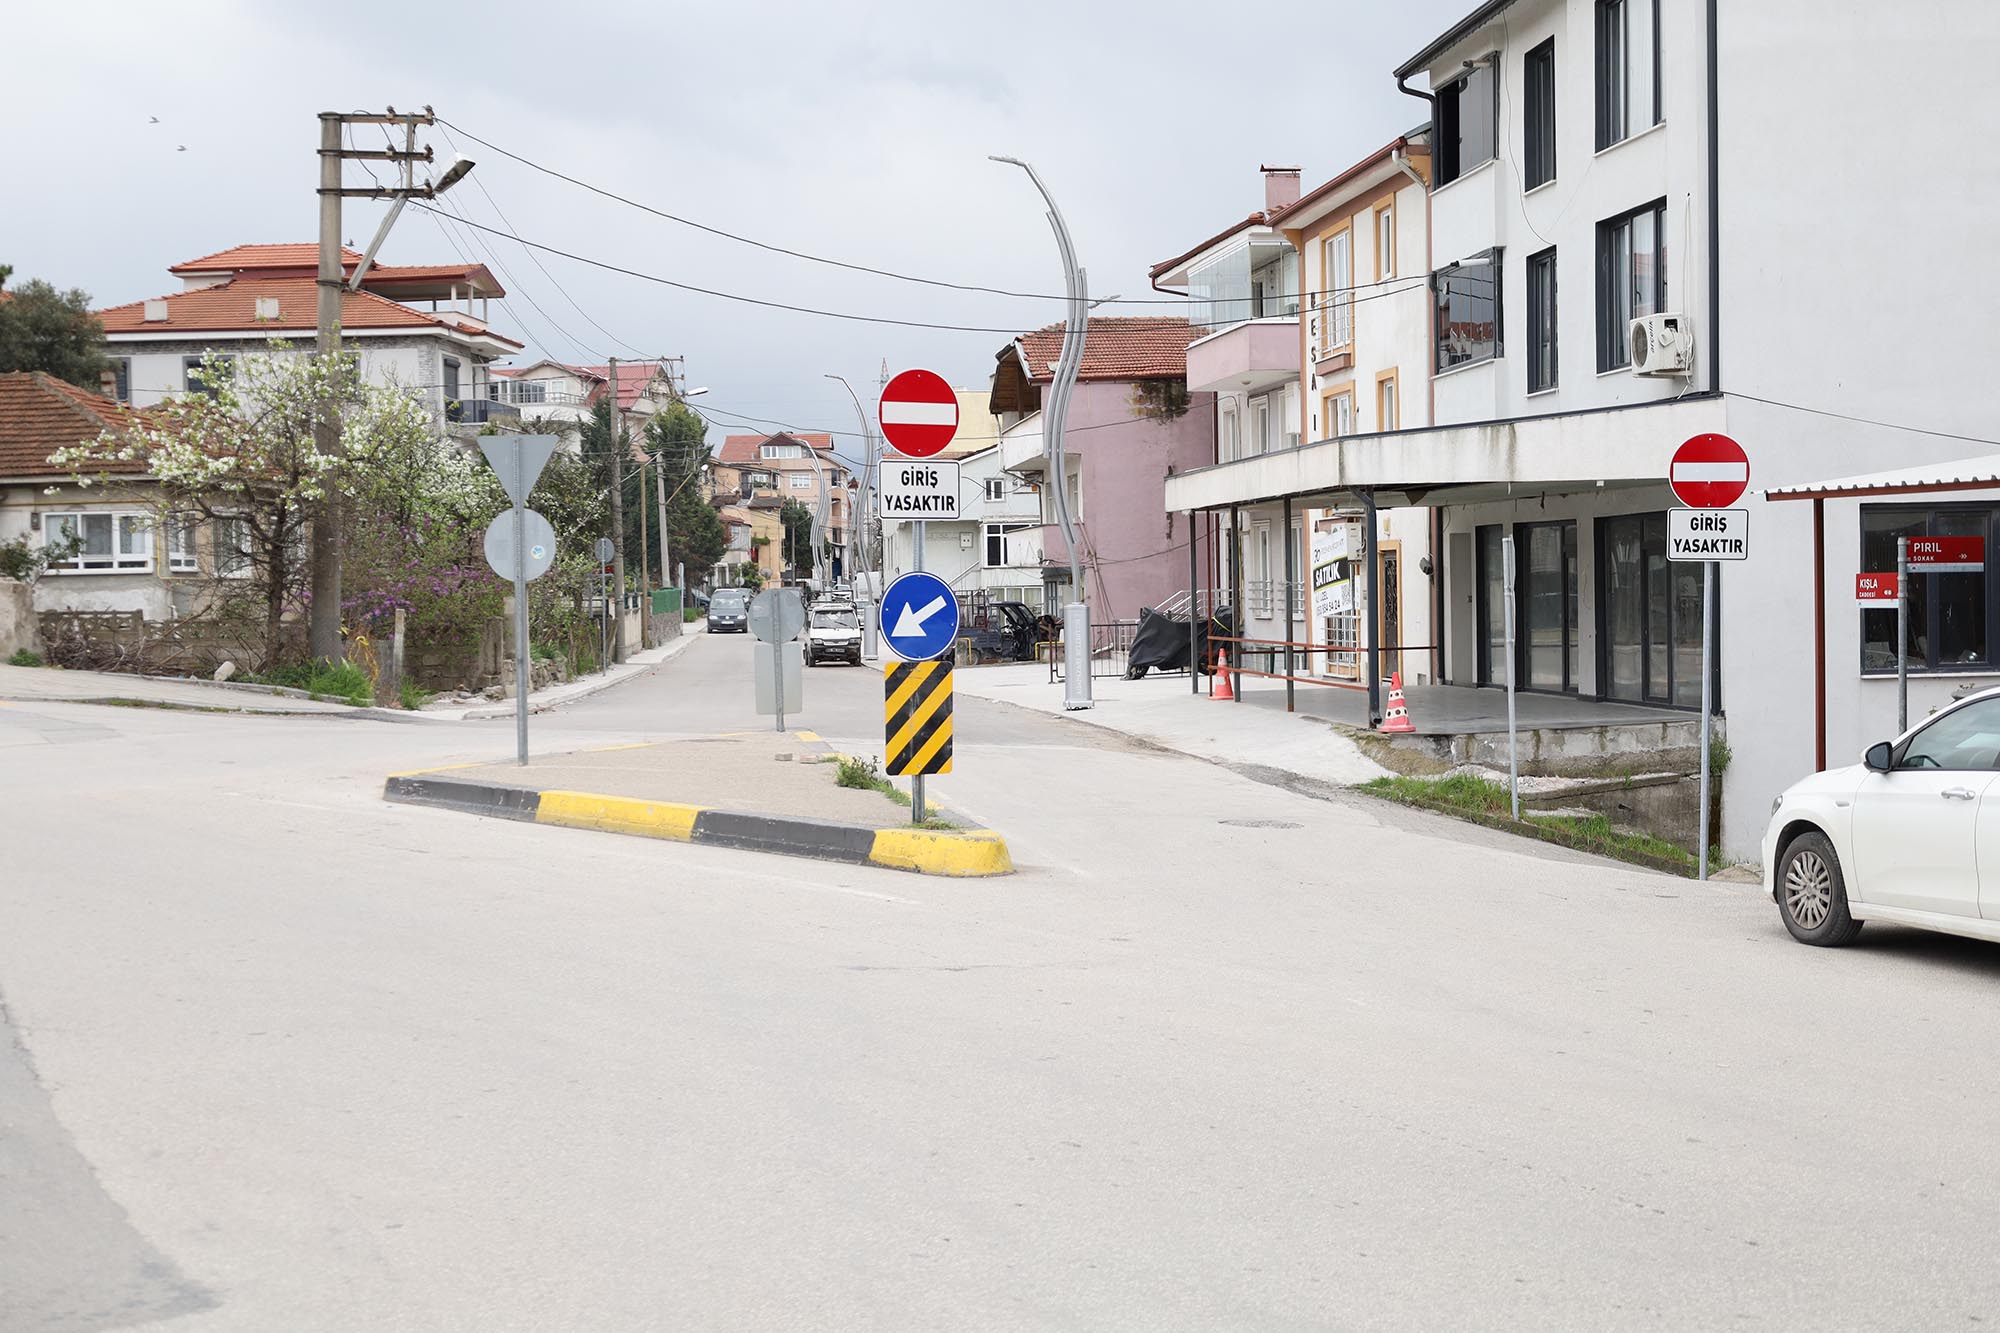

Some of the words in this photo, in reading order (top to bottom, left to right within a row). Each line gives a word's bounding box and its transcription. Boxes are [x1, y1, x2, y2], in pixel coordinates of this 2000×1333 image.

[901, 466, 938, 488] GİRİŞ
[884, 495, 955, 511] YASAKTIR
[1690, 513, 1727, 533] GİRİŞ
[1673, 538, 1743, 553] YASAKTIR
[1913, 542, 1942, 553] PIRIL
[1316, 561, 1341, 587] SATILIK
[1860, 579, 1878, 590] KIŞLA
